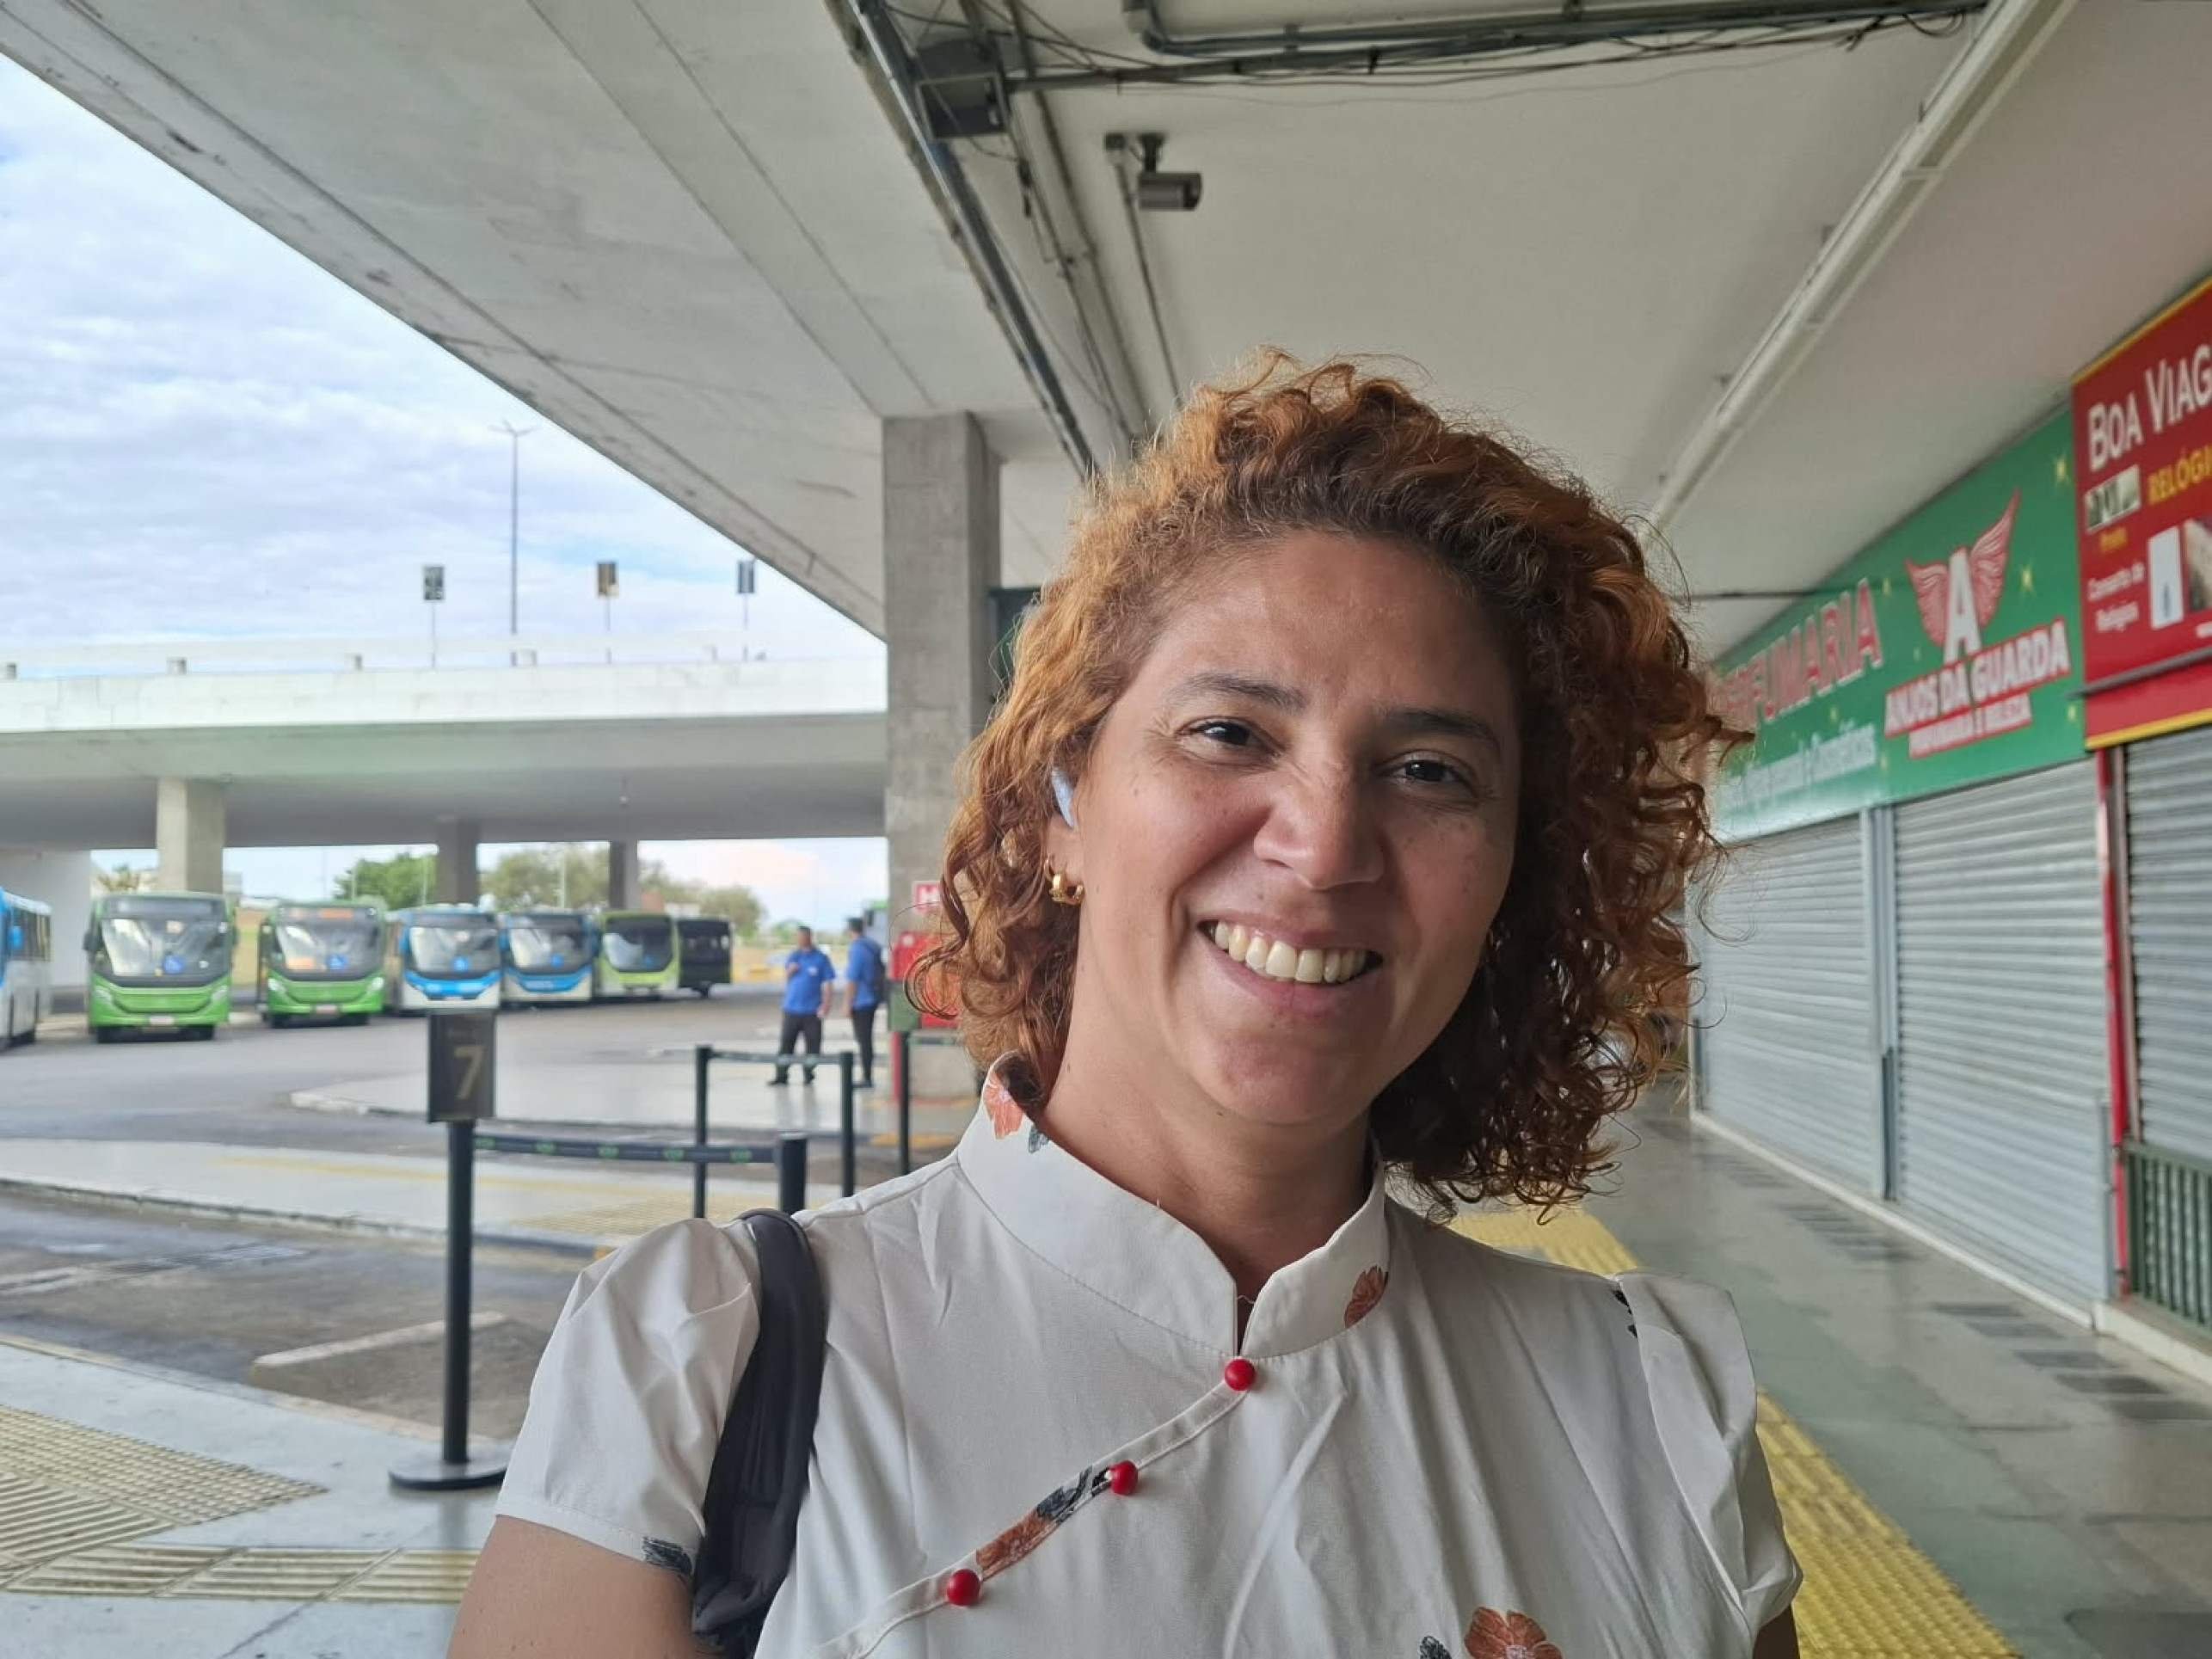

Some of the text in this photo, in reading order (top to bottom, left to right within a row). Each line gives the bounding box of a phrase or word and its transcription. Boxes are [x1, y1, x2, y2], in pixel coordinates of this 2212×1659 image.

[2089, 345, 2212, 470] BOA VIAG
[1943, 546, 1982, 666] A
[1969, 617, 2072, 708] GUARDA
[454, 1045, 486, 1100] 7
